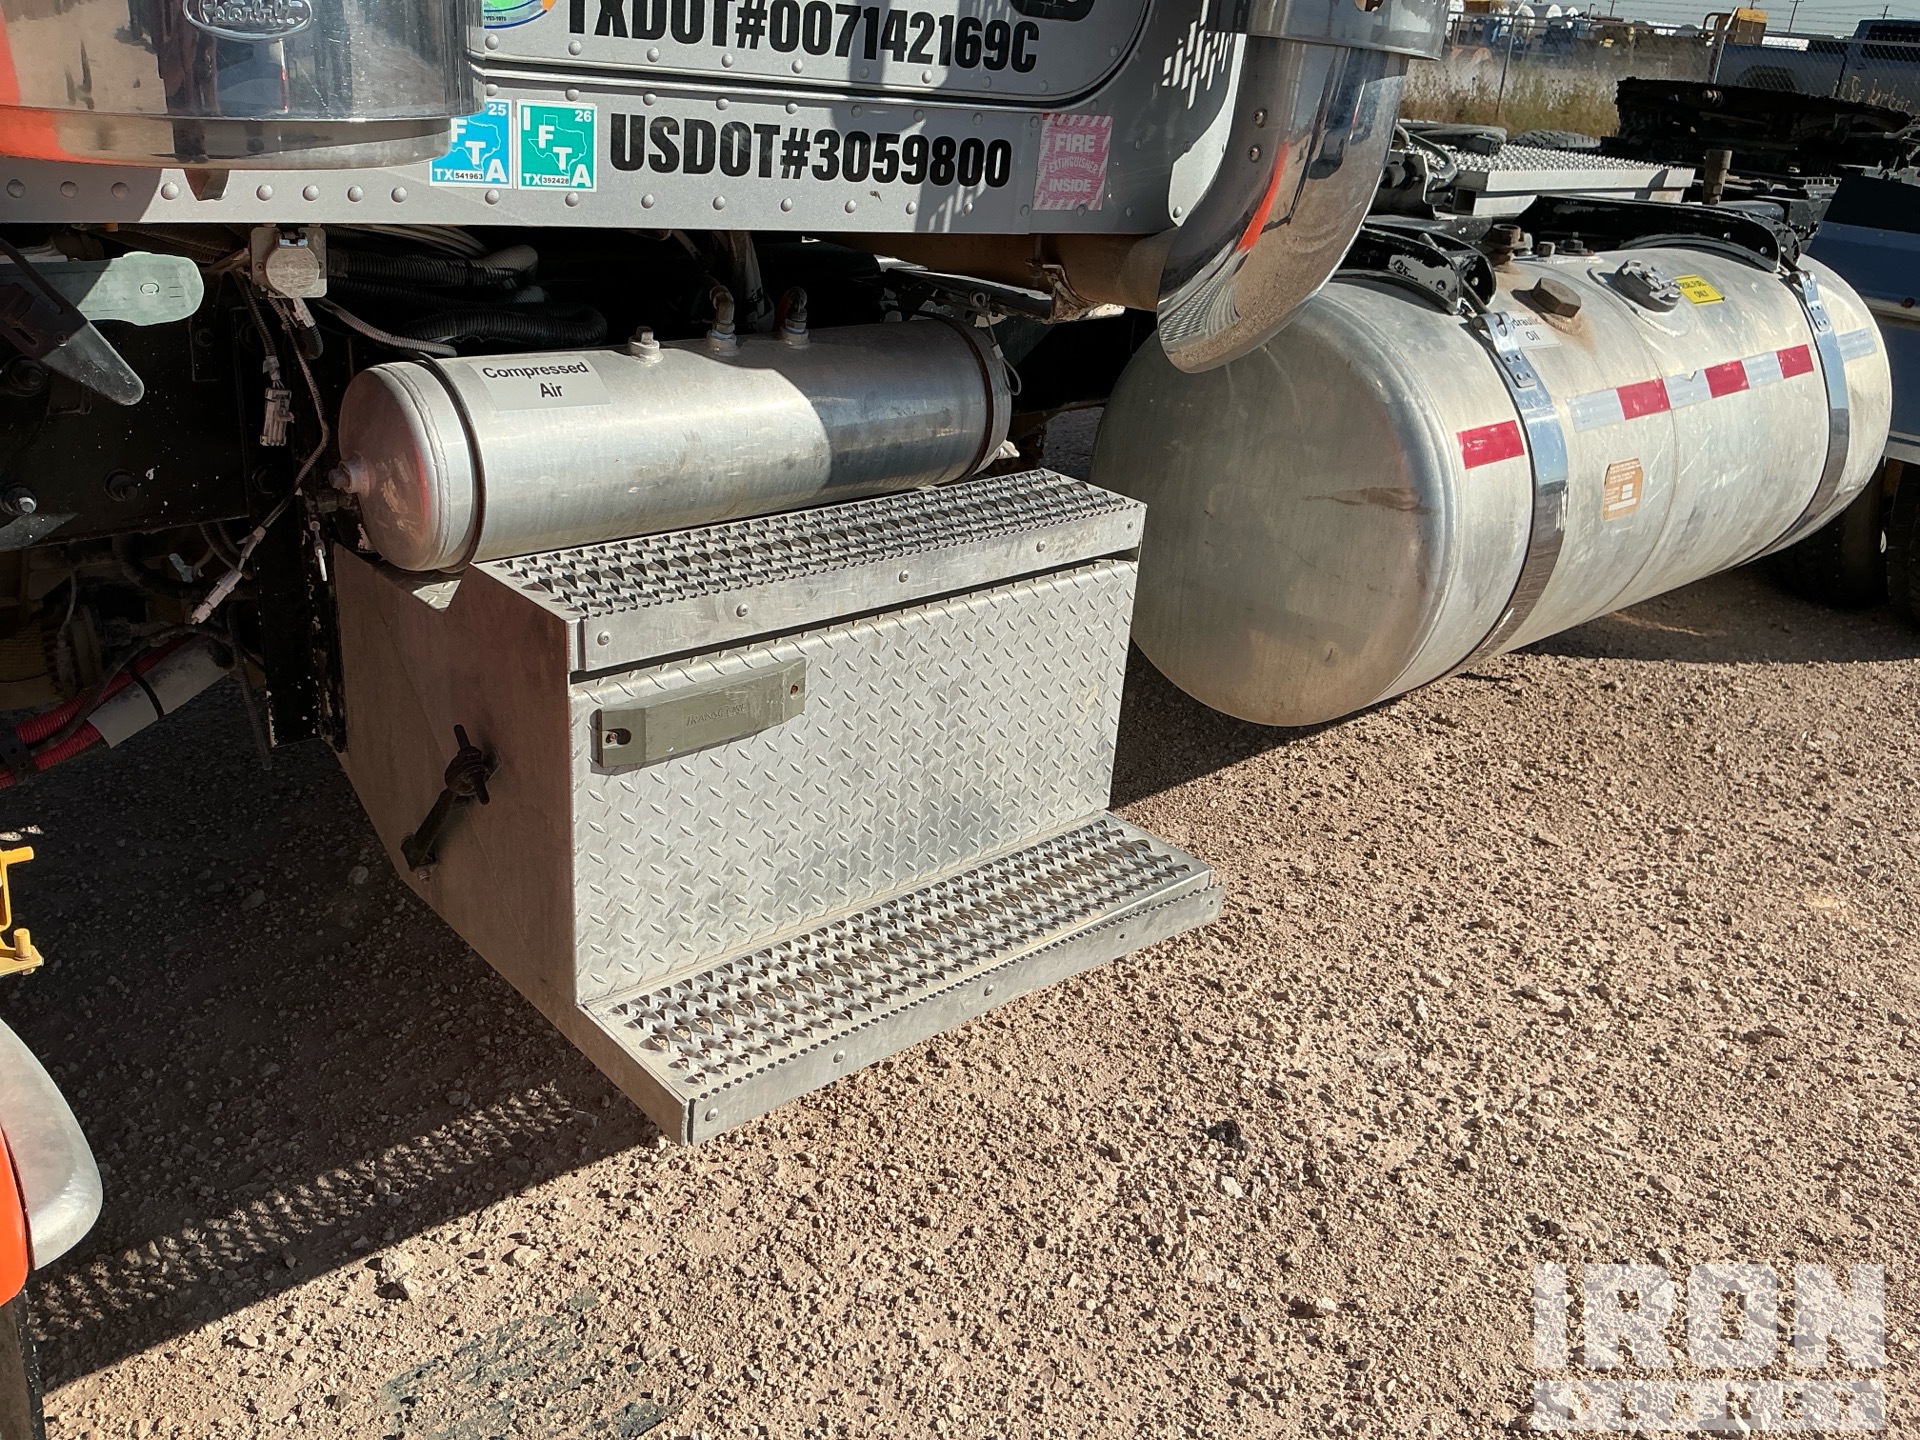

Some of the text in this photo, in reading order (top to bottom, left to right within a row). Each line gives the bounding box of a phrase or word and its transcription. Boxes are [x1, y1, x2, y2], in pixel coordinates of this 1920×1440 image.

[569, 0, 1040, 74] TXDOT#007142169C
[488, 103, 507, 116] 25
[574, 110, 593, 123] 26
[610, 112, 1012, 188] USDOT#3059800
[1054, 133, 1096, 153] FIRE
[1049, 156, 1099, 174] EXTINGUISHER
[434, 168, 484, 181] TX 541963
[523, 173, 570, 186] TX 392428
[1048, 178, 1092, 192] INSIDE
[1525, 330, 1541, 341] Oil
[482, 361, 590, 379] Compressed
[539, 382, 563, 398] Air
